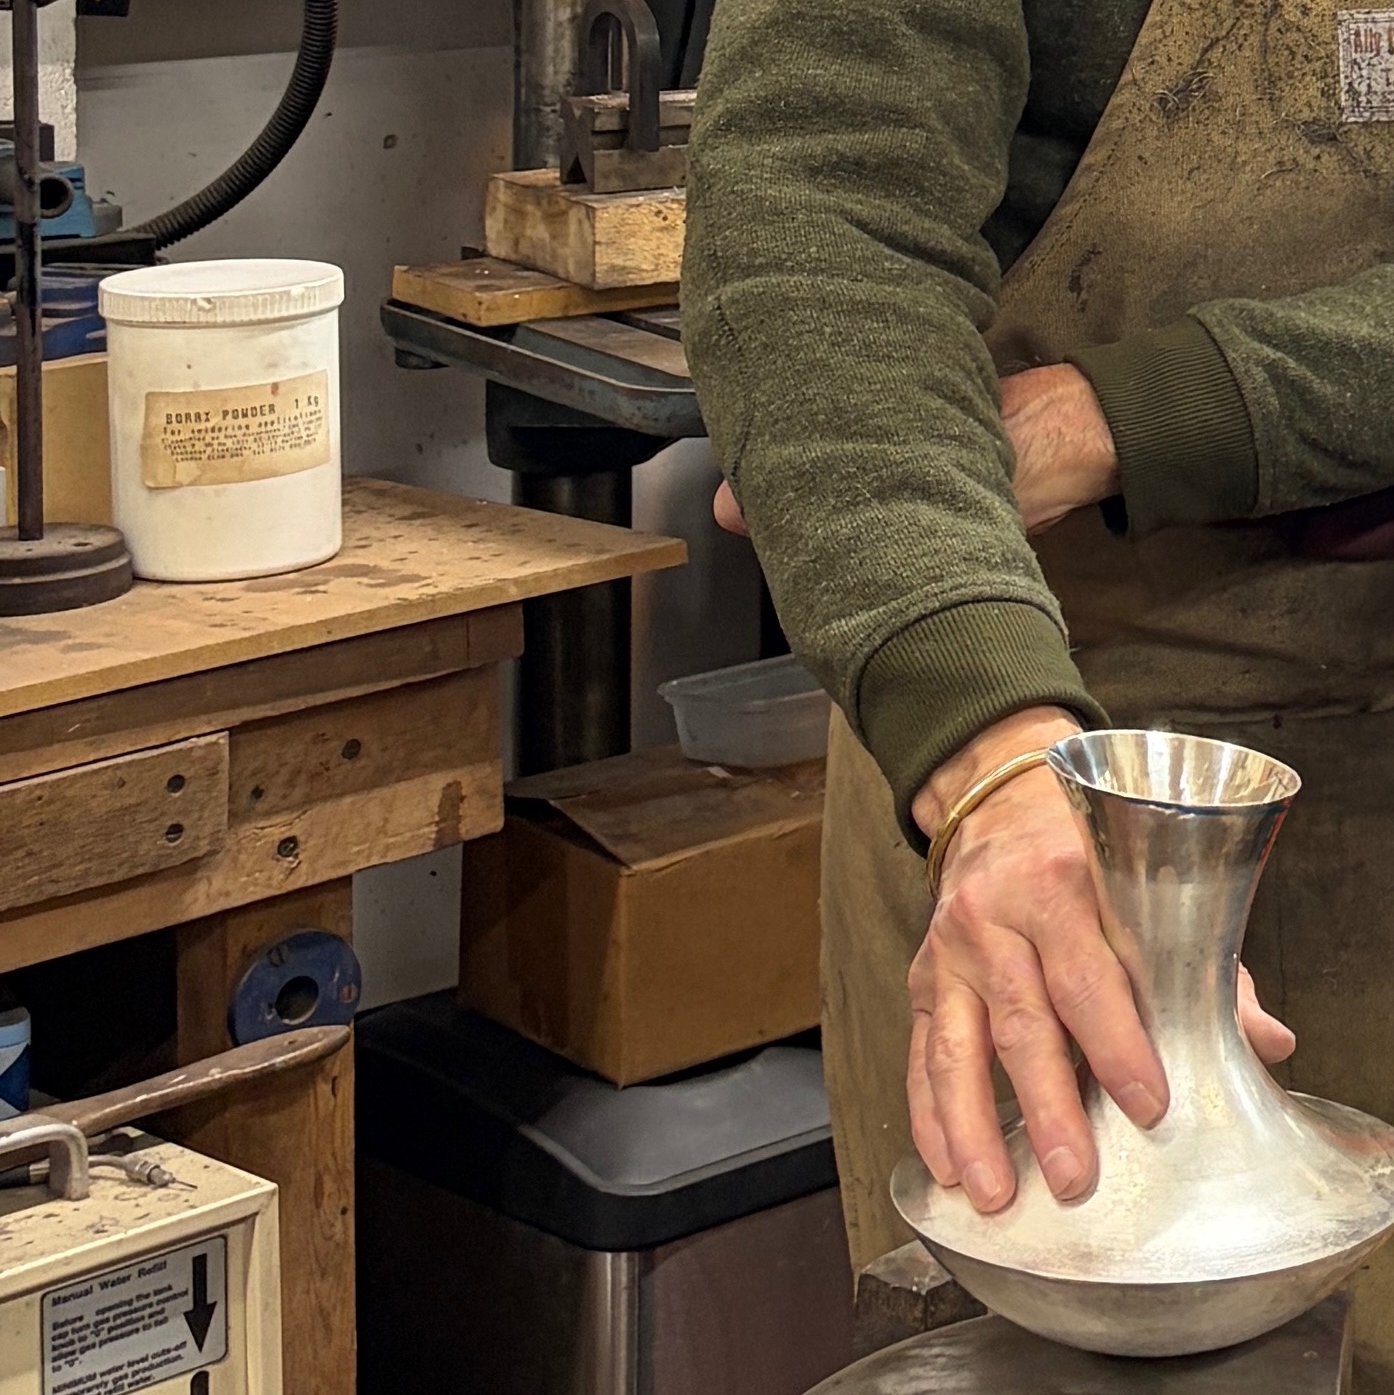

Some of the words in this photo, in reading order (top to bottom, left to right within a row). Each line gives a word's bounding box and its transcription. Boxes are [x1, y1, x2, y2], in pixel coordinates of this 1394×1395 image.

[165, 411, 211, 425] BORAX
[222, 403, 276, 421] POWDER
[52, 1284, 94, 1307] Manual
[98, 1273, 132, 1291] Water
[137, 1260, 167, 1278] Refill
[136, 1291, 151, 1303] the
[153, 1284, 173, 1297] tank
[93, 1316, 111, 1329] gas
[112, 1302, 154, 1323] pressure
[156, 1287, 189, 1306] control
[77, 1334, 88, 1344] to
[107, 1314, 146, 1336] position
[148, 1307, 166, 1320] and
[79, 1341, 97, 1356] gas
[98, 1326, 140, 1349] pressure
[142, 1322, 153, 1332] to
[52, 1363, 62, 1374] to
[100, 1363, 126, 1379] water
[127, 1353, 149, 1369] level
[151, 1340, 187, 1360] cuts-off
[112, 1372, 129, 1385] gas
[131, 1353, 185, 1379] production.
[127, 1374, 156, 1389] water.
